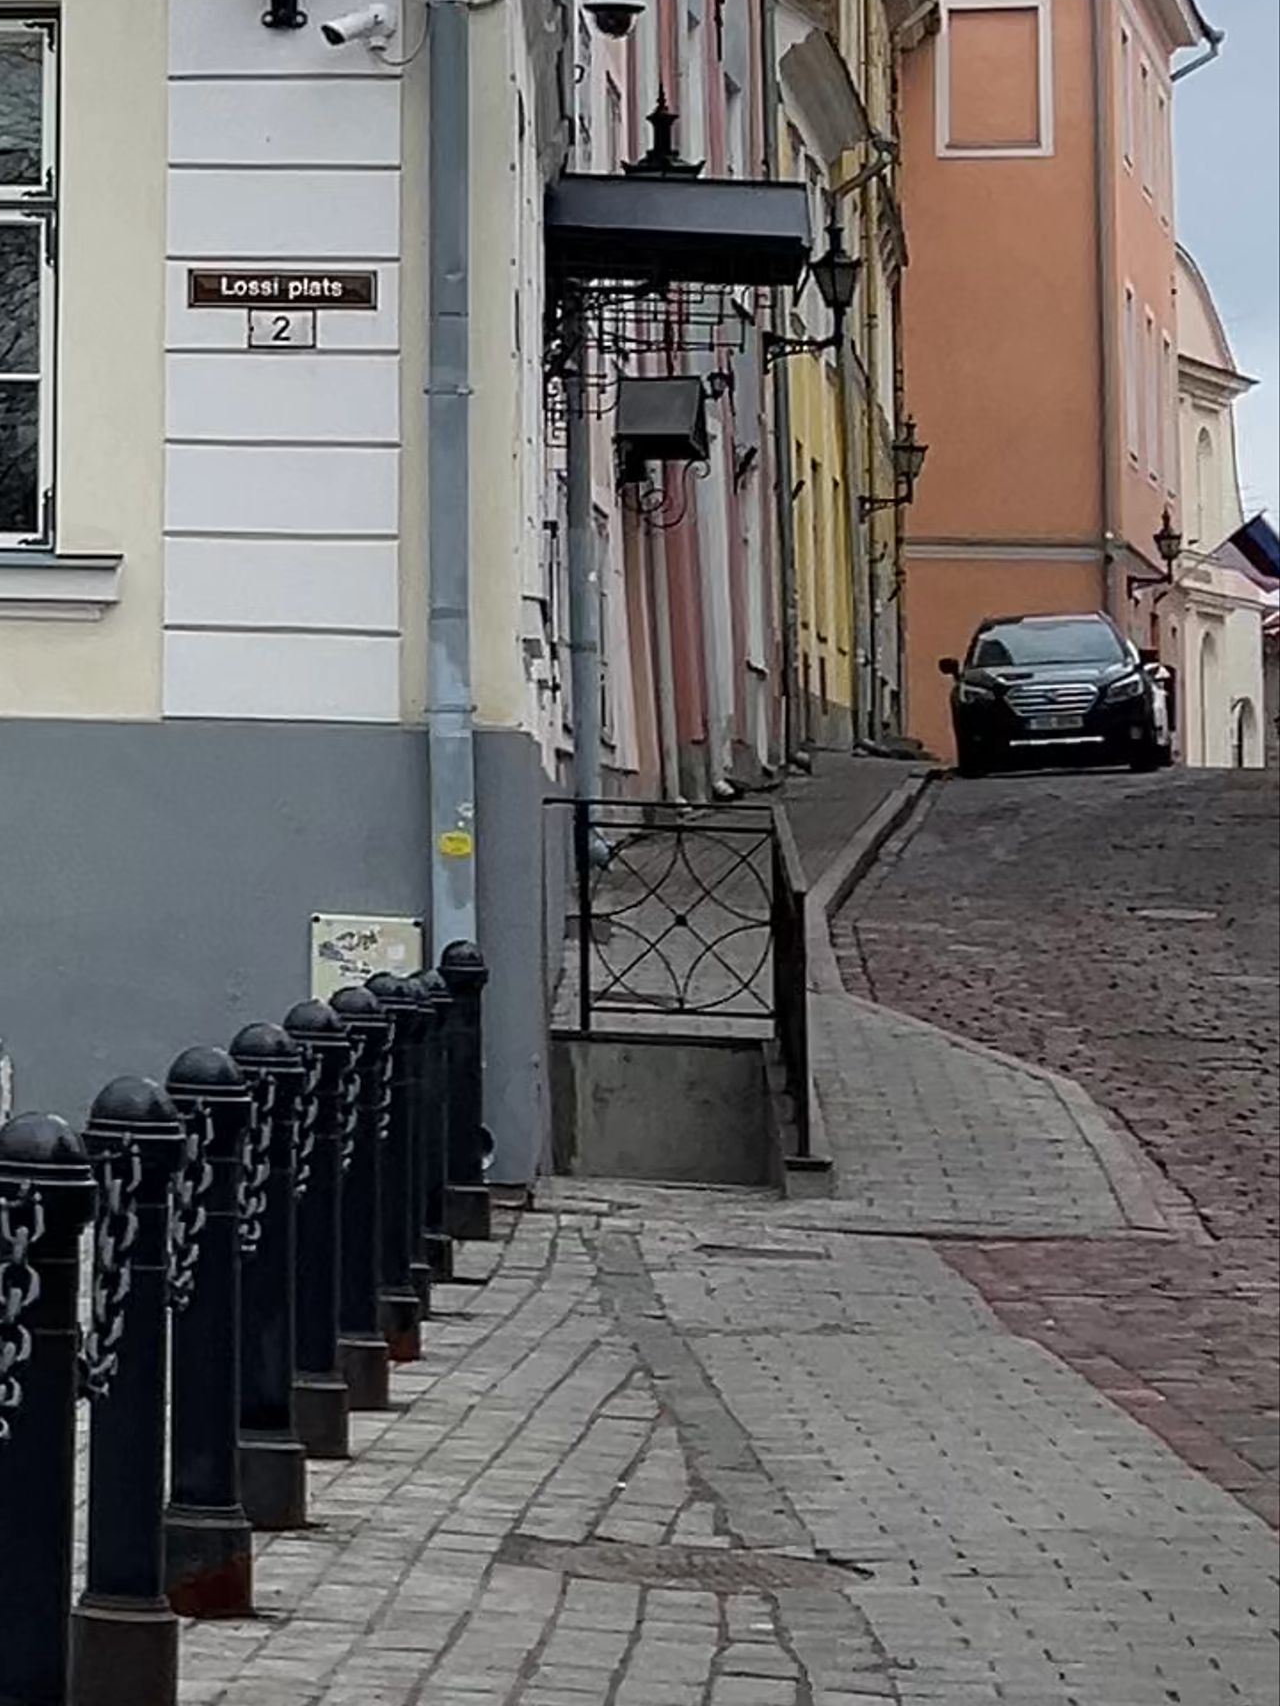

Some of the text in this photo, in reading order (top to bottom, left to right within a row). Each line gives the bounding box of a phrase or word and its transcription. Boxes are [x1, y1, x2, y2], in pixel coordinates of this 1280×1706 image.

[221, 276, 342, 299] Lossi plats
[272, 315, 291, 341] 2
